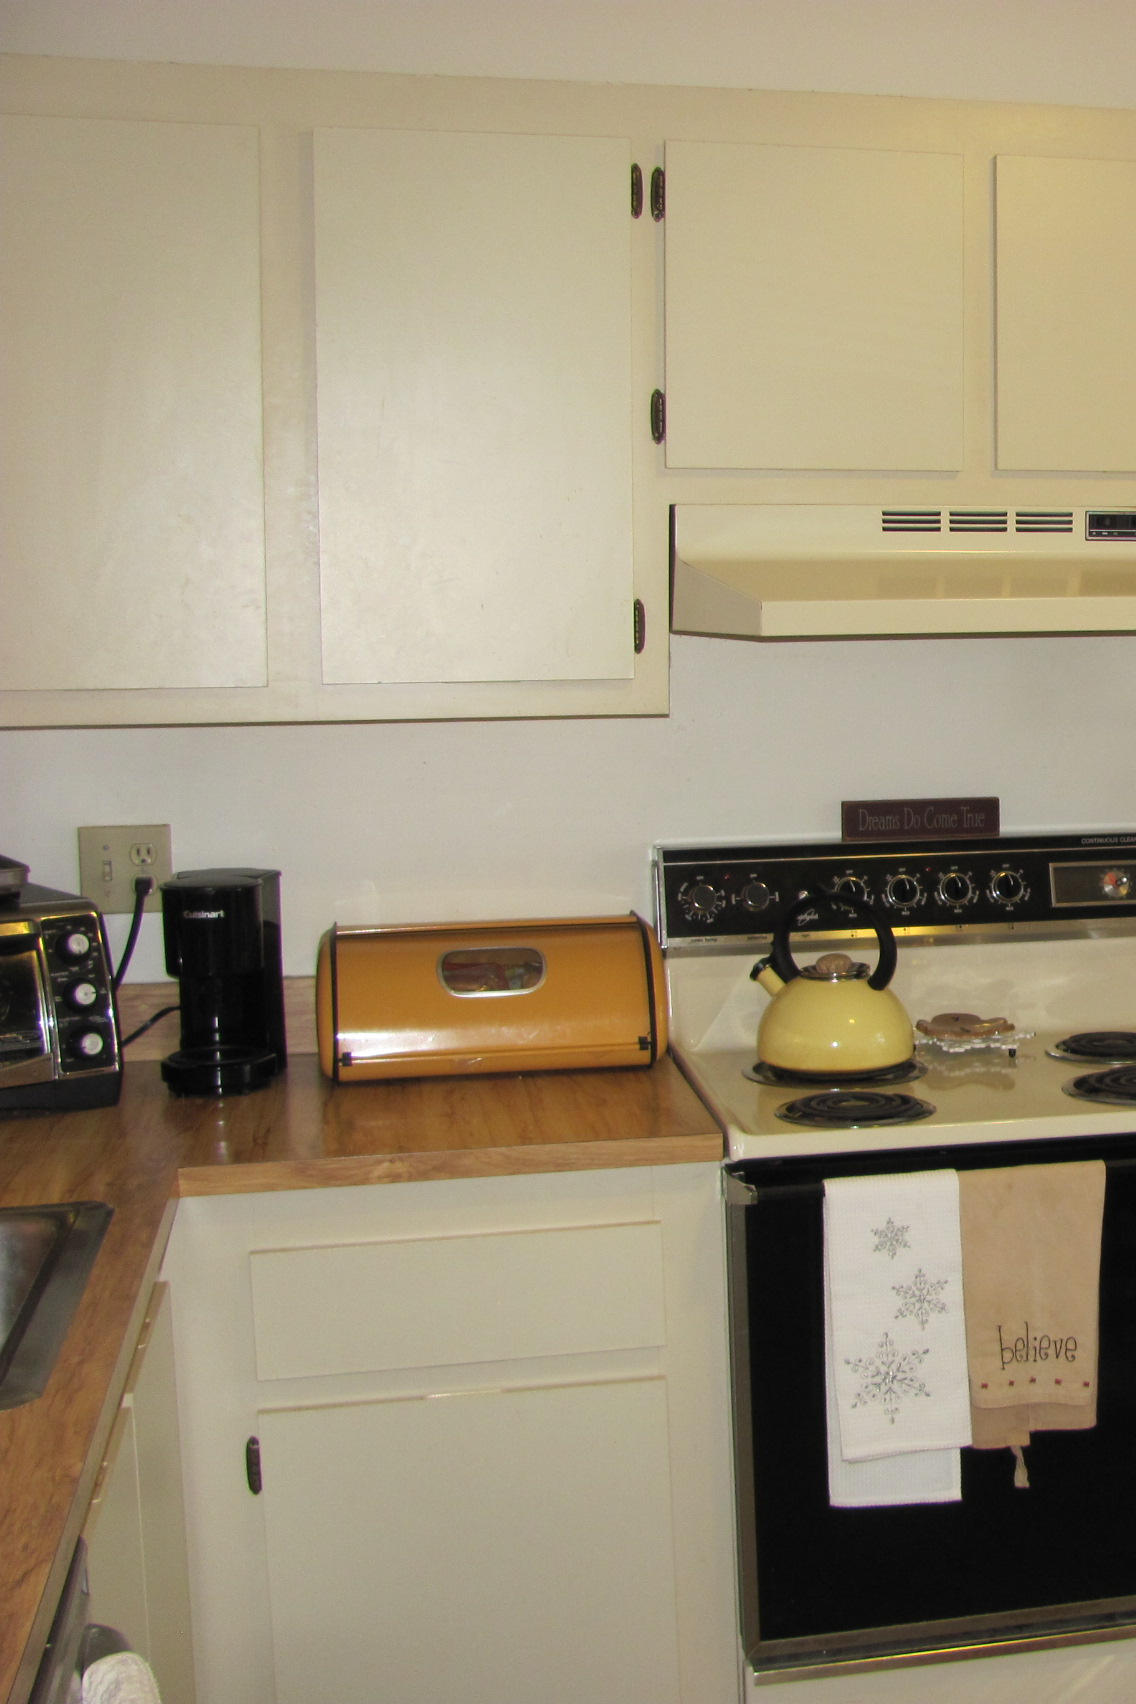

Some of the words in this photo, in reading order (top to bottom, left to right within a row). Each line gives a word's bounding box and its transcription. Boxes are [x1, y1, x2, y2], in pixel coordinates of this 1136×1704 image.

[858, 808, 901, 832] Dreams
[904, 807, 921, 830] Do
[924, 805, 958, 830] Come
[960, 806, 985, 829] True
[183, 909, 225, 919] Cuisinart
[997, 1321, 1079, 1370] believe
